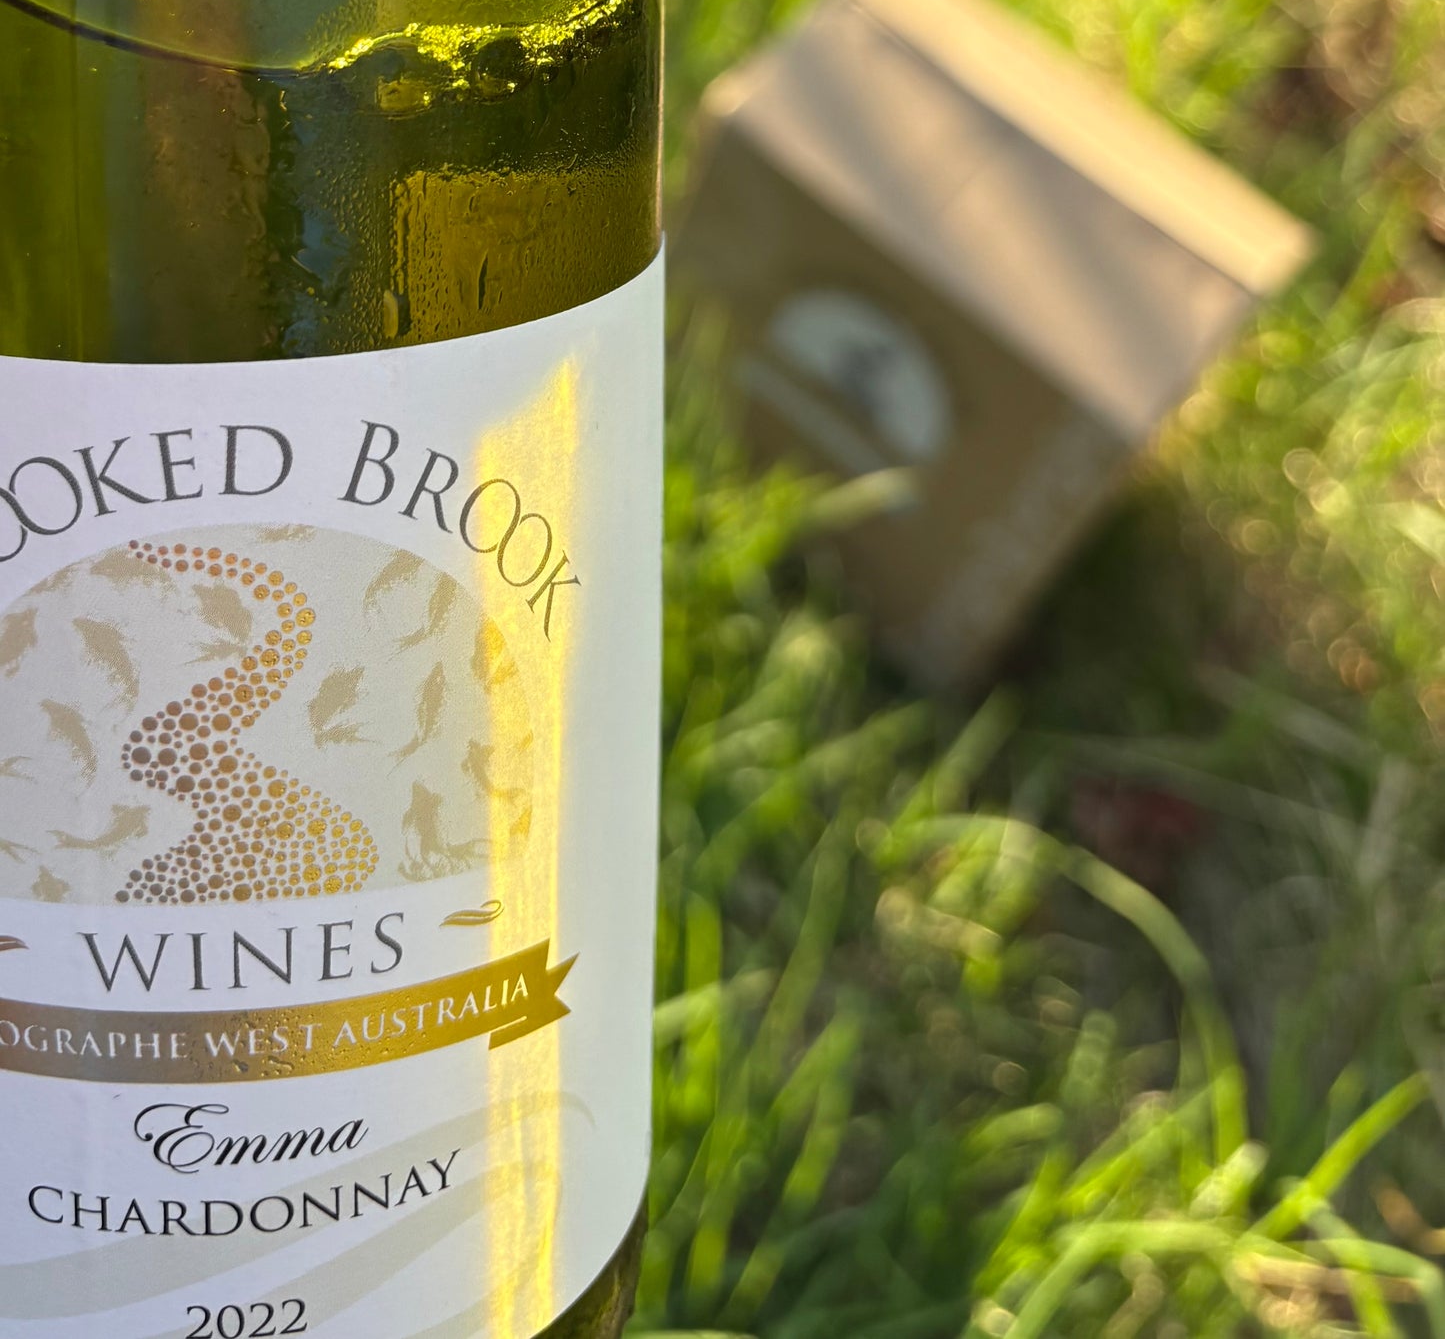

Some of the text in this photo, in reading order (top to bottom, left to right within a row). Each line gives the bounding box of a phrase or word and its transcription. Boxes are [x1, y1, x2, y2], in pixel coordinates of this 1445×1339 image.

[339, 420, 581, 641] BROOK
[78, 912, 405, 992] WINES
[204, 1018, 322, 1057] WEST
[334, 972, 529, 1047] AUSTRALIA
[133, 1103, 368, 1173] Emma
[28, 1150, 461, 1236] CHARDONNAY
[185, 1299, 308, 1339] 2022
